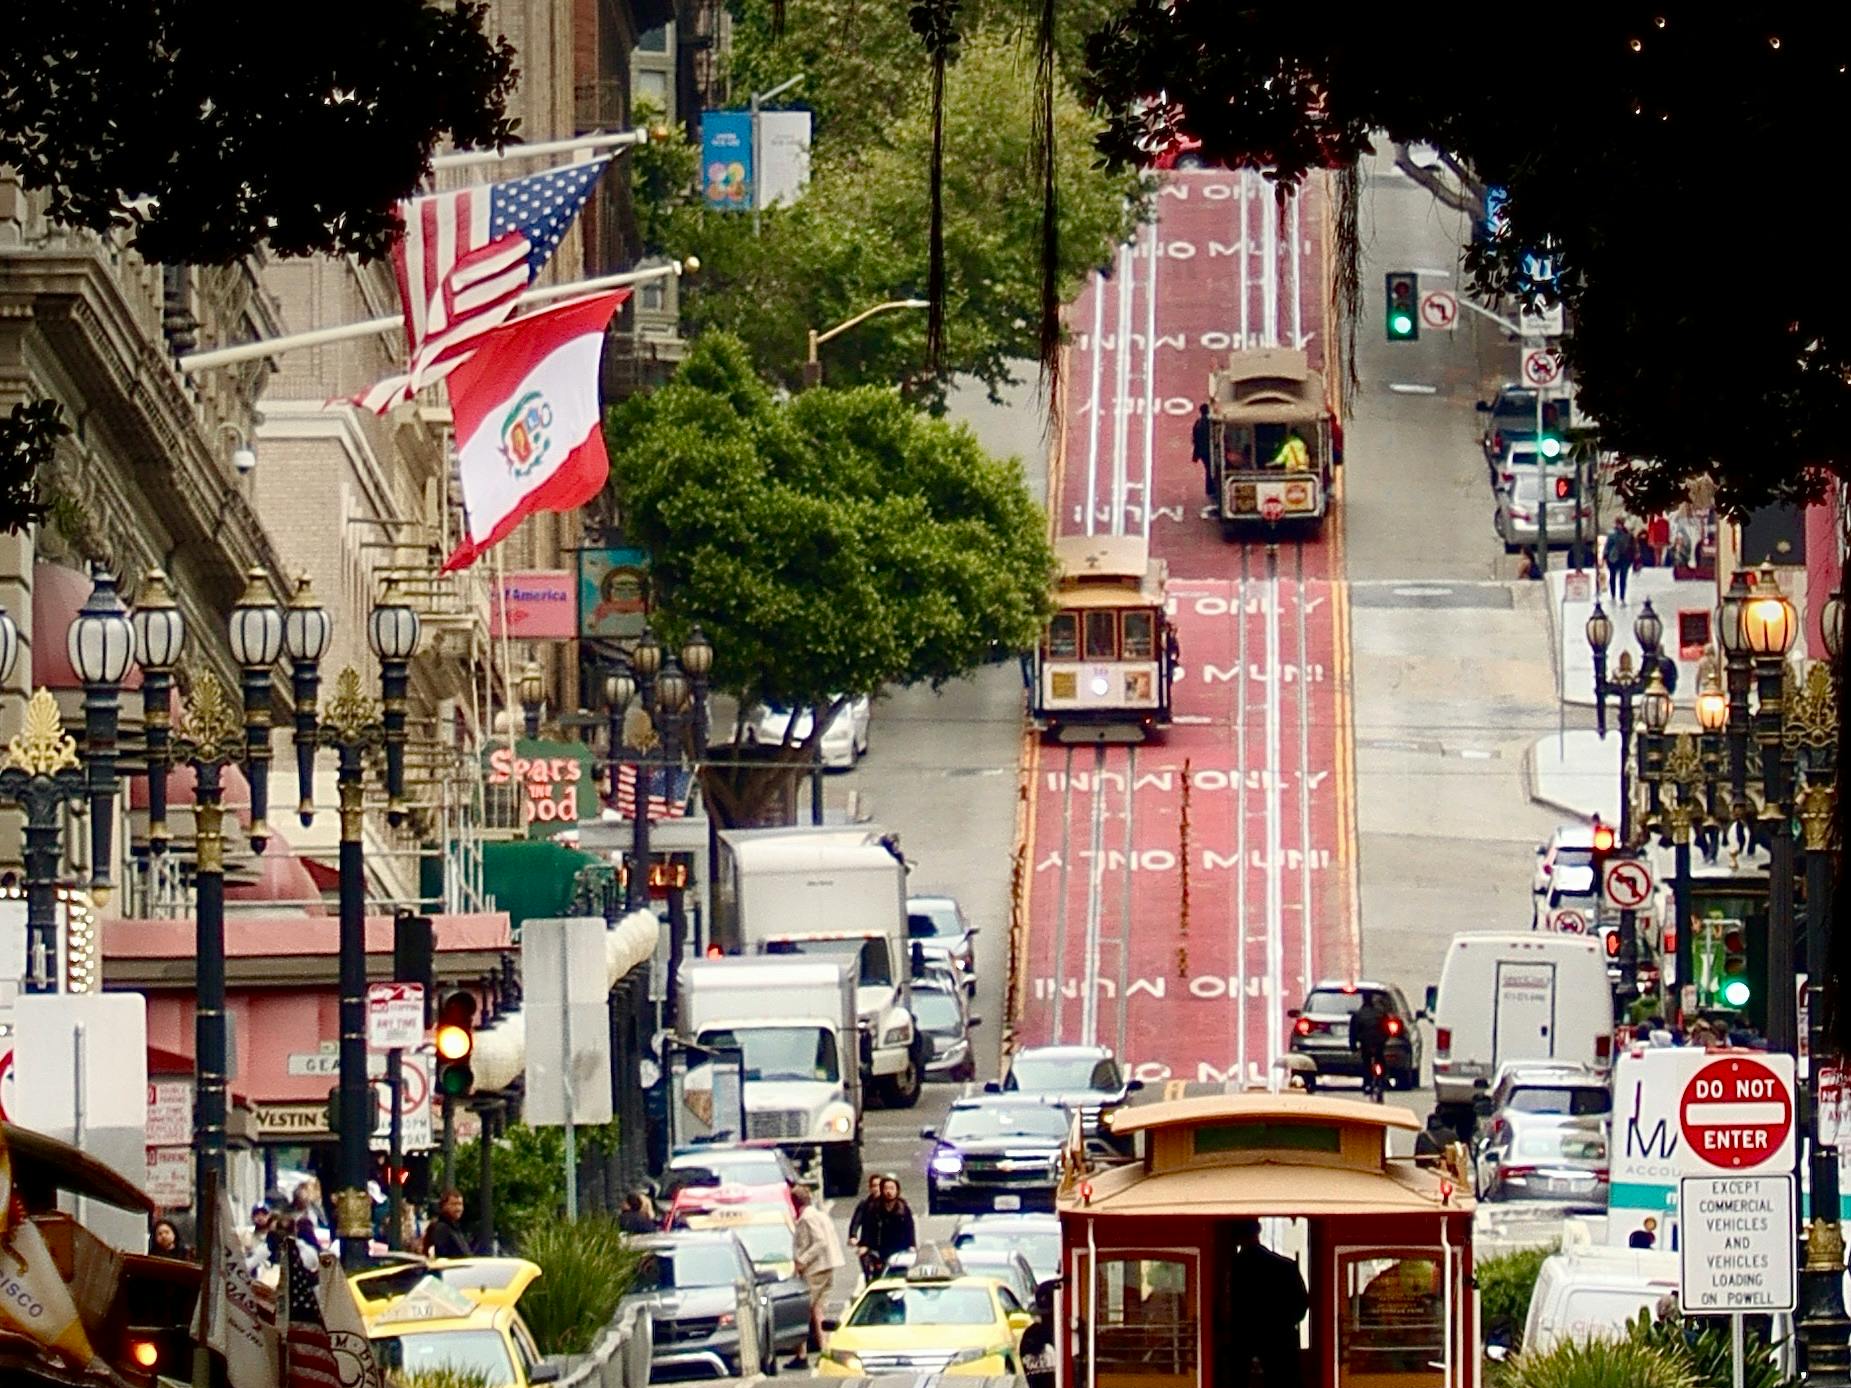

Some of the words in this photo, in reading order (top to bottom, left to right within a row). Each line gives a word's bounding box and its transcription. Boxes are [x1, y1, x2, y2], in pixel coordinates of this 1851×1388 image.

[513, 588, 567, 601] America
[1194, 596, 1326, 617] ONLY
[1203, 663, 1324, 684] MUNI
[488, 747, 581, 783] Sears
[1048, 770, 1172, 792] MUNI
[1194, 769, 1328, 791] ONLY
[1037, 849, 1176, 872] ONLY
[1202, 849, 1330, 872] MUNI
[1034, 975, 1166, 1000] MUNI
[1188, 975, 1306, 999] ONL
[1695, 1079, 1724, 1099] DO
[1736, 1078, 1776, 1098] NOT
[1703, 1130, 1768, 1150] ENTER
[1712, 1180, 1761, 1195] EXCEPT
[1699, 1199, 1774, 1213] COMMERCIAL
[1706, 1217, 1768, 1231] VEHICLES
[1724, 1236, 1751, 1250] AND
[1706, 1255, 1769, 1269] VEHICLES
[1712, 1274, 1764, 1288] LOADING
[1701, 1293, 1718, 1306] ON
[1727, 1292, 1774, 1306] POWELL
